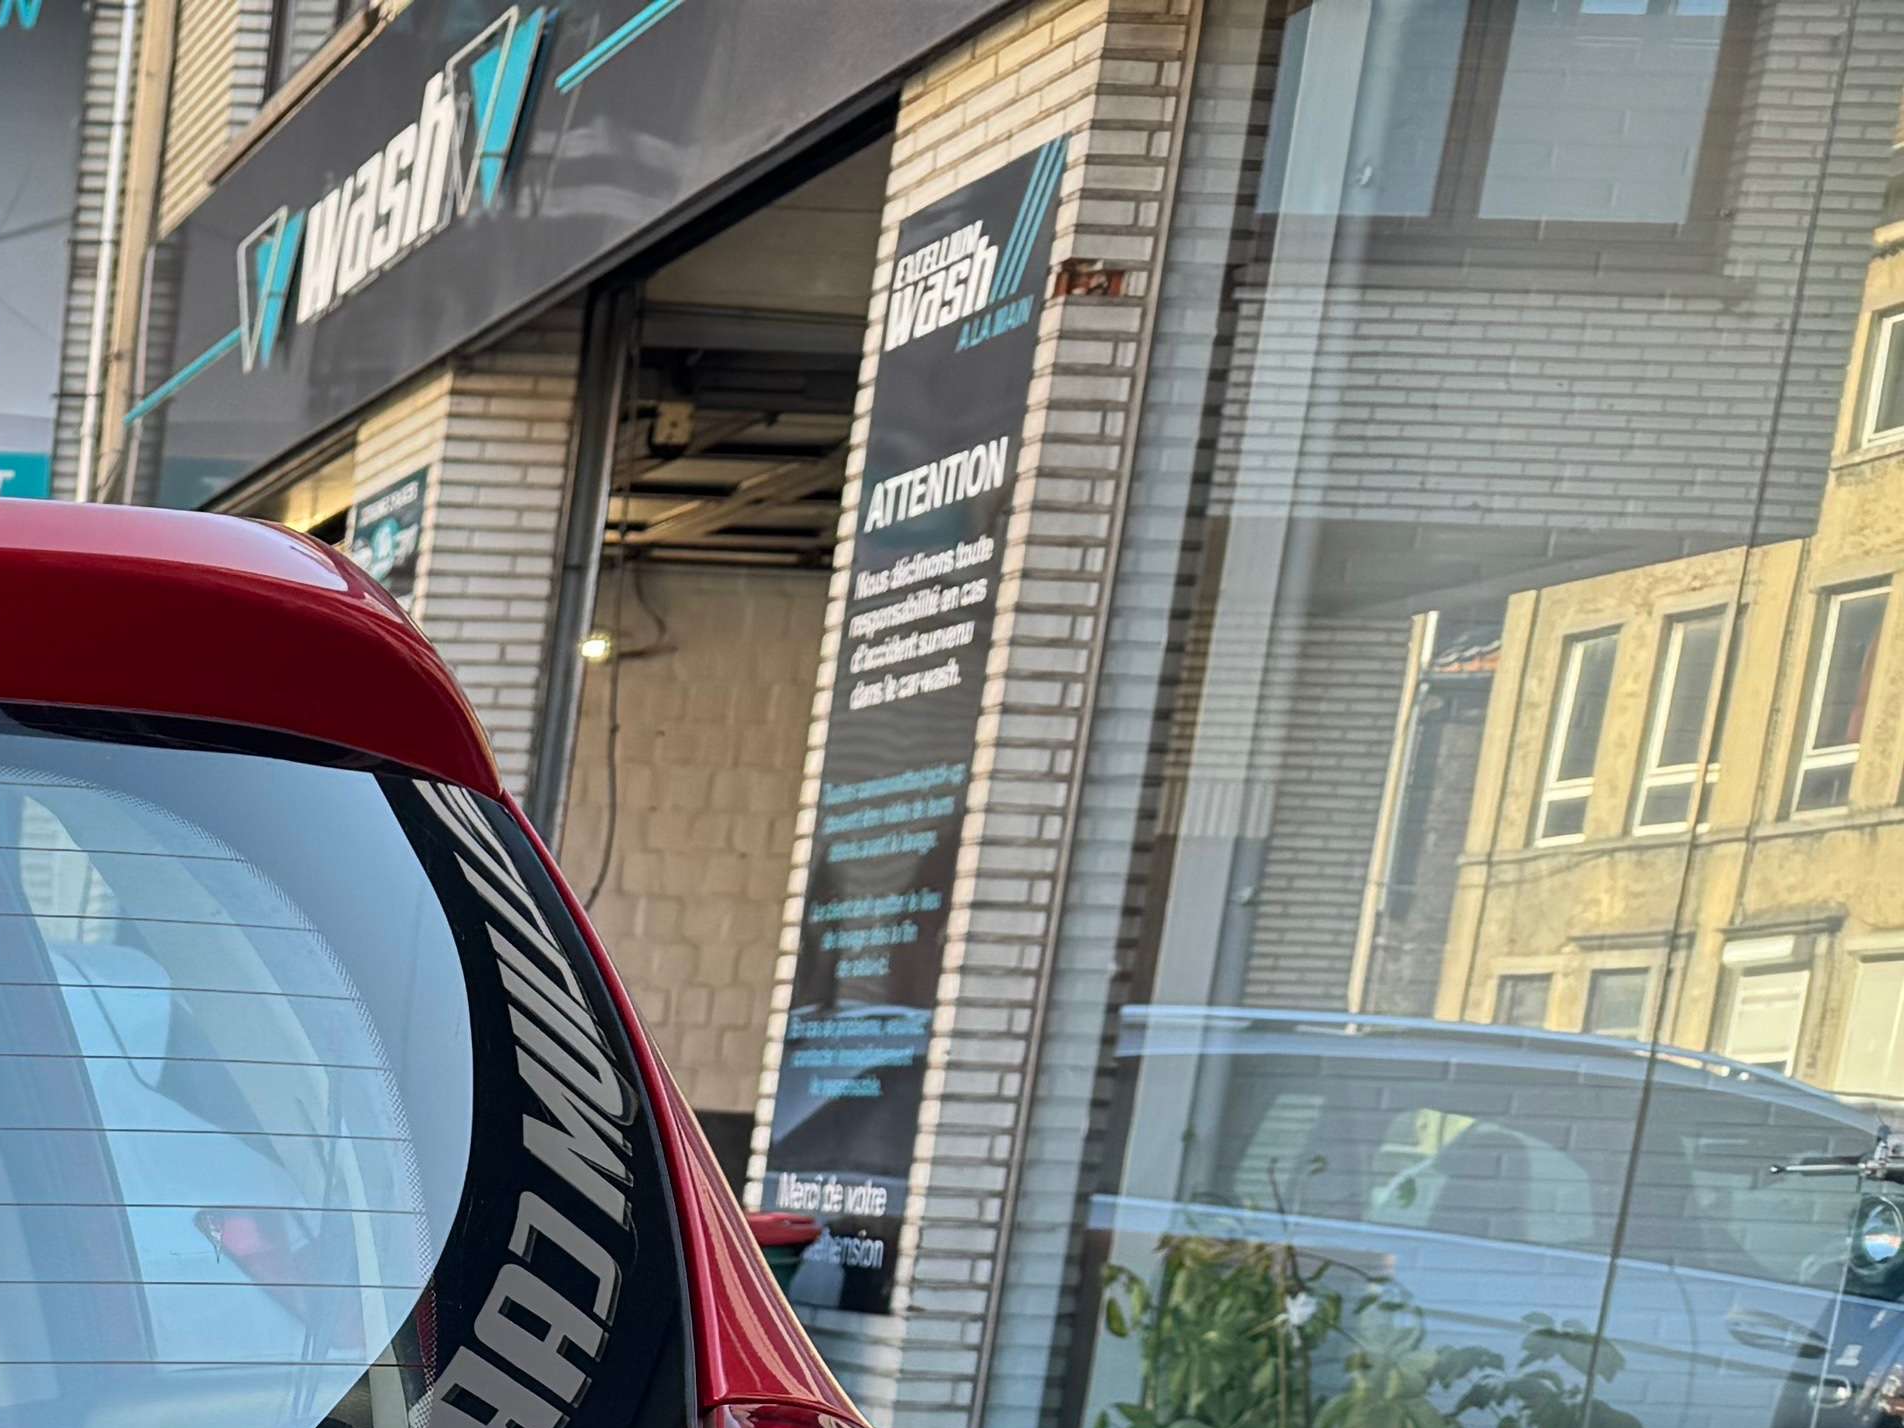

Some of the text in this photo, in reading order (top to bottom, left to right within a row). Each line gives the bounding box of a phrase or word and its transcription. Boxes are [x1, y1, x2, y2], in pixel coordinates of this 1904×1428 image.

[863, 436, 1009, 534] ATTENTION
[960, 577, 989, 607] cas
[775, 1171, 888, 1217] Merci de votre
